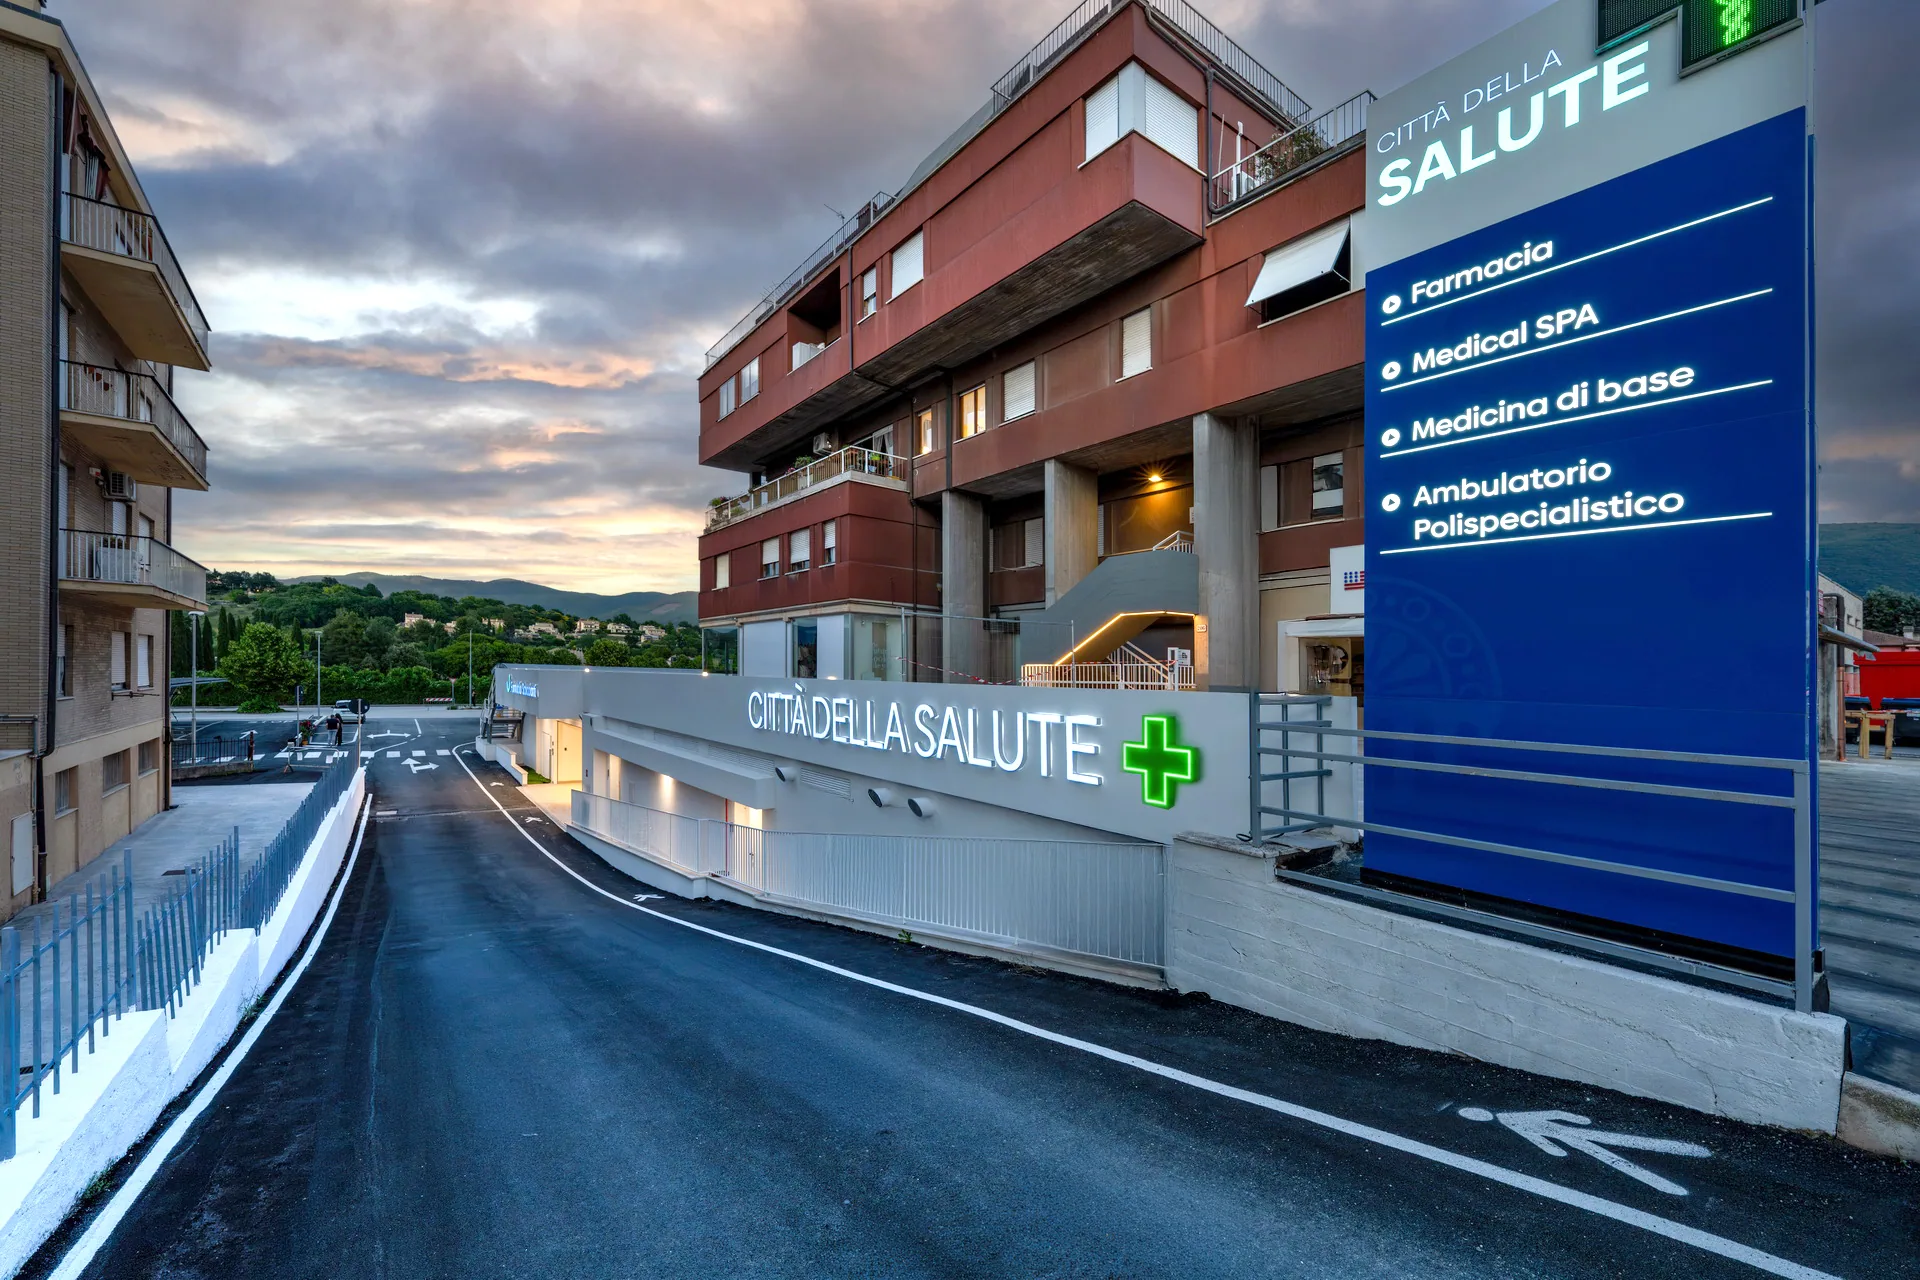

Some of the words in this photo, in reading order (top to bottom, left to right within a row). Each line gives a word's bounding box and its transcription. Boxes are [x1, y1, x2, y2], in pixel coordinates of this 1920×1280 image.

[1377, 101, 1451, 154] CITTÀ
[1463, 49, 1562, 114] DELLA
[1377, 41, 1649, 207] SALUTE
[1412, 241, 1553, 304] Farmacia
[1412, 321, 1527, 374] Medical
[1535, 303, 1599, 339] SPA
[1412, 400, 1548, 442] Medicina
[1556, 381, 1589, 411] di
[1597, 366, 1695, 404] base
[1413, 458, 1612, 507] Ambulatorio
[1414, 490, 1685, 541] Polispecialistico
[748, 683, 812, 737] CITTÀ
[812, 696, 910, 753] DELLA
[914, 704, 1104, 785] SALUTE
